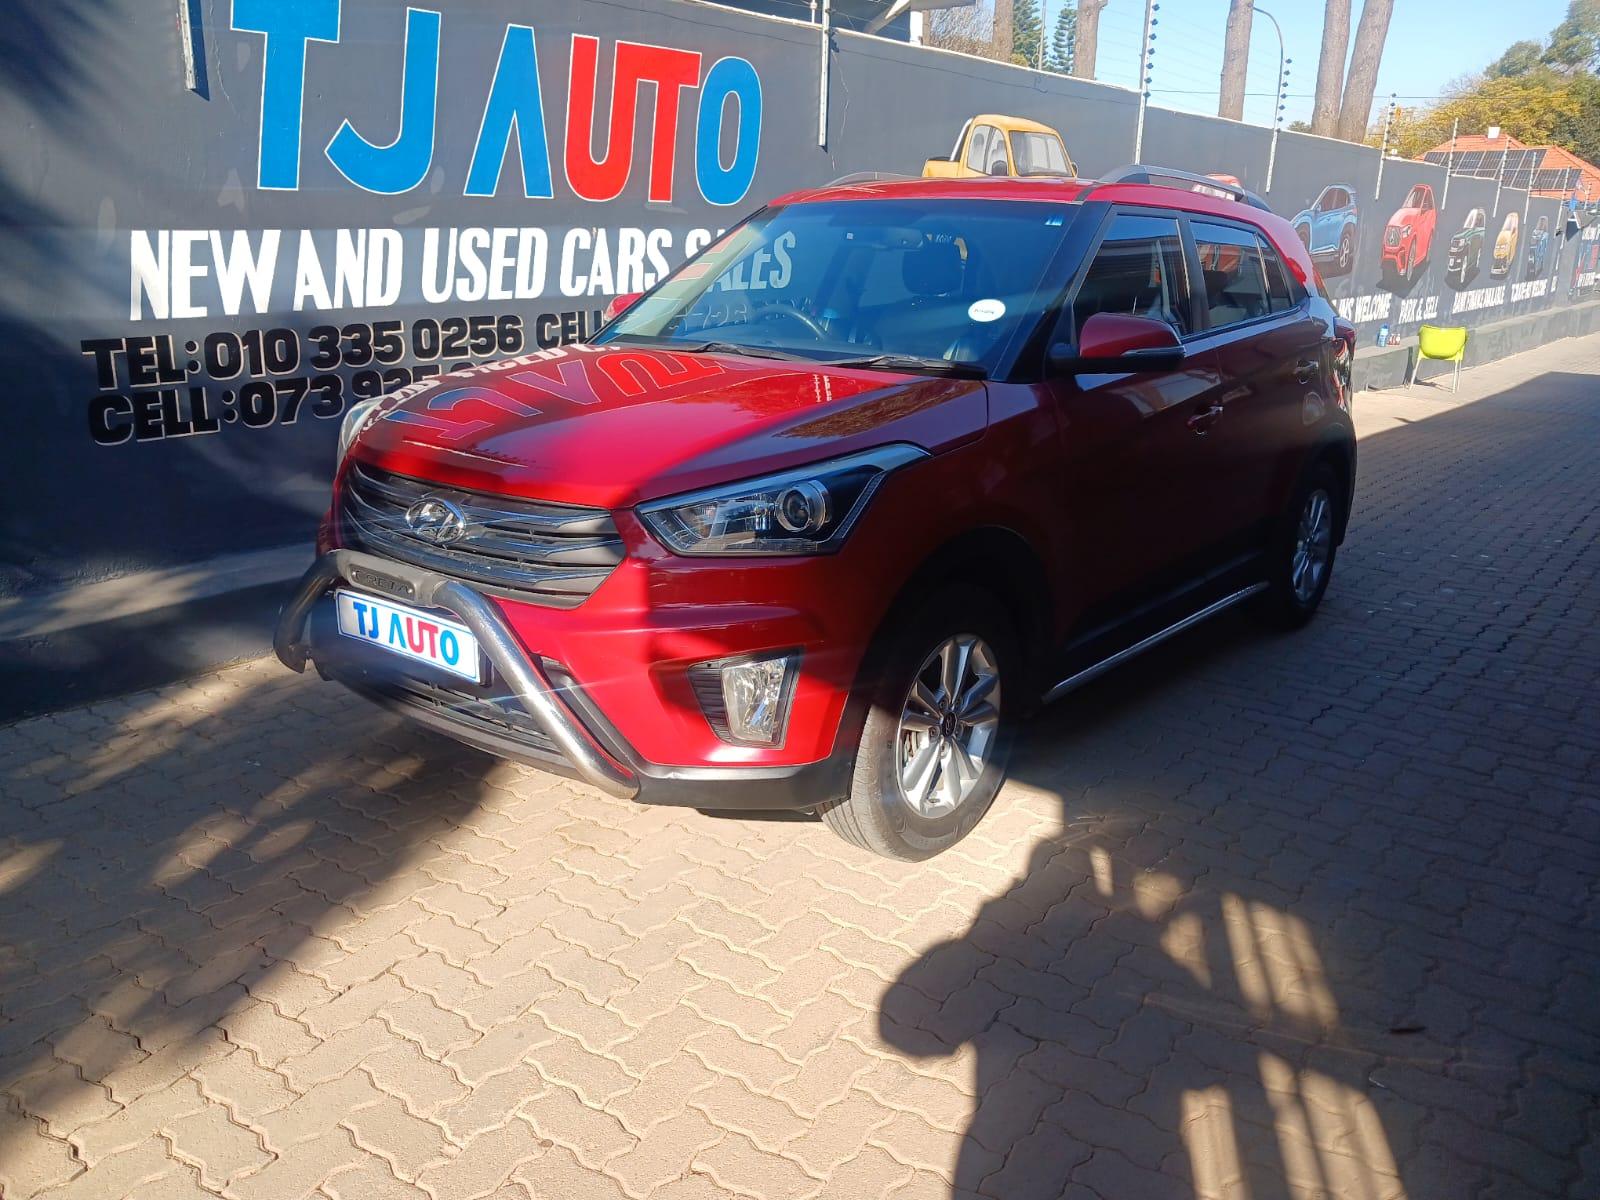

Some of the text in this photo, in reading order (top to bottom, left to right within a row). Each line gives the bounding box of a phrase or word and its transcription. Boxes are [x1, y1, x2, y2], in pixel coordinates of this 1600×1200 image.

[229, 0, 763, 206] TJ AUTO
[130, 229, 281, 321] NEW
[292, 228, 404, 311] AND
[421, 226, 548, 303] USED
[559, 226, 673, 297] CARS
[308, 320, 404, 371] 335
[411, 314, 524, 361] 0256
[353, 601, 460, 666] TJ AUTO
